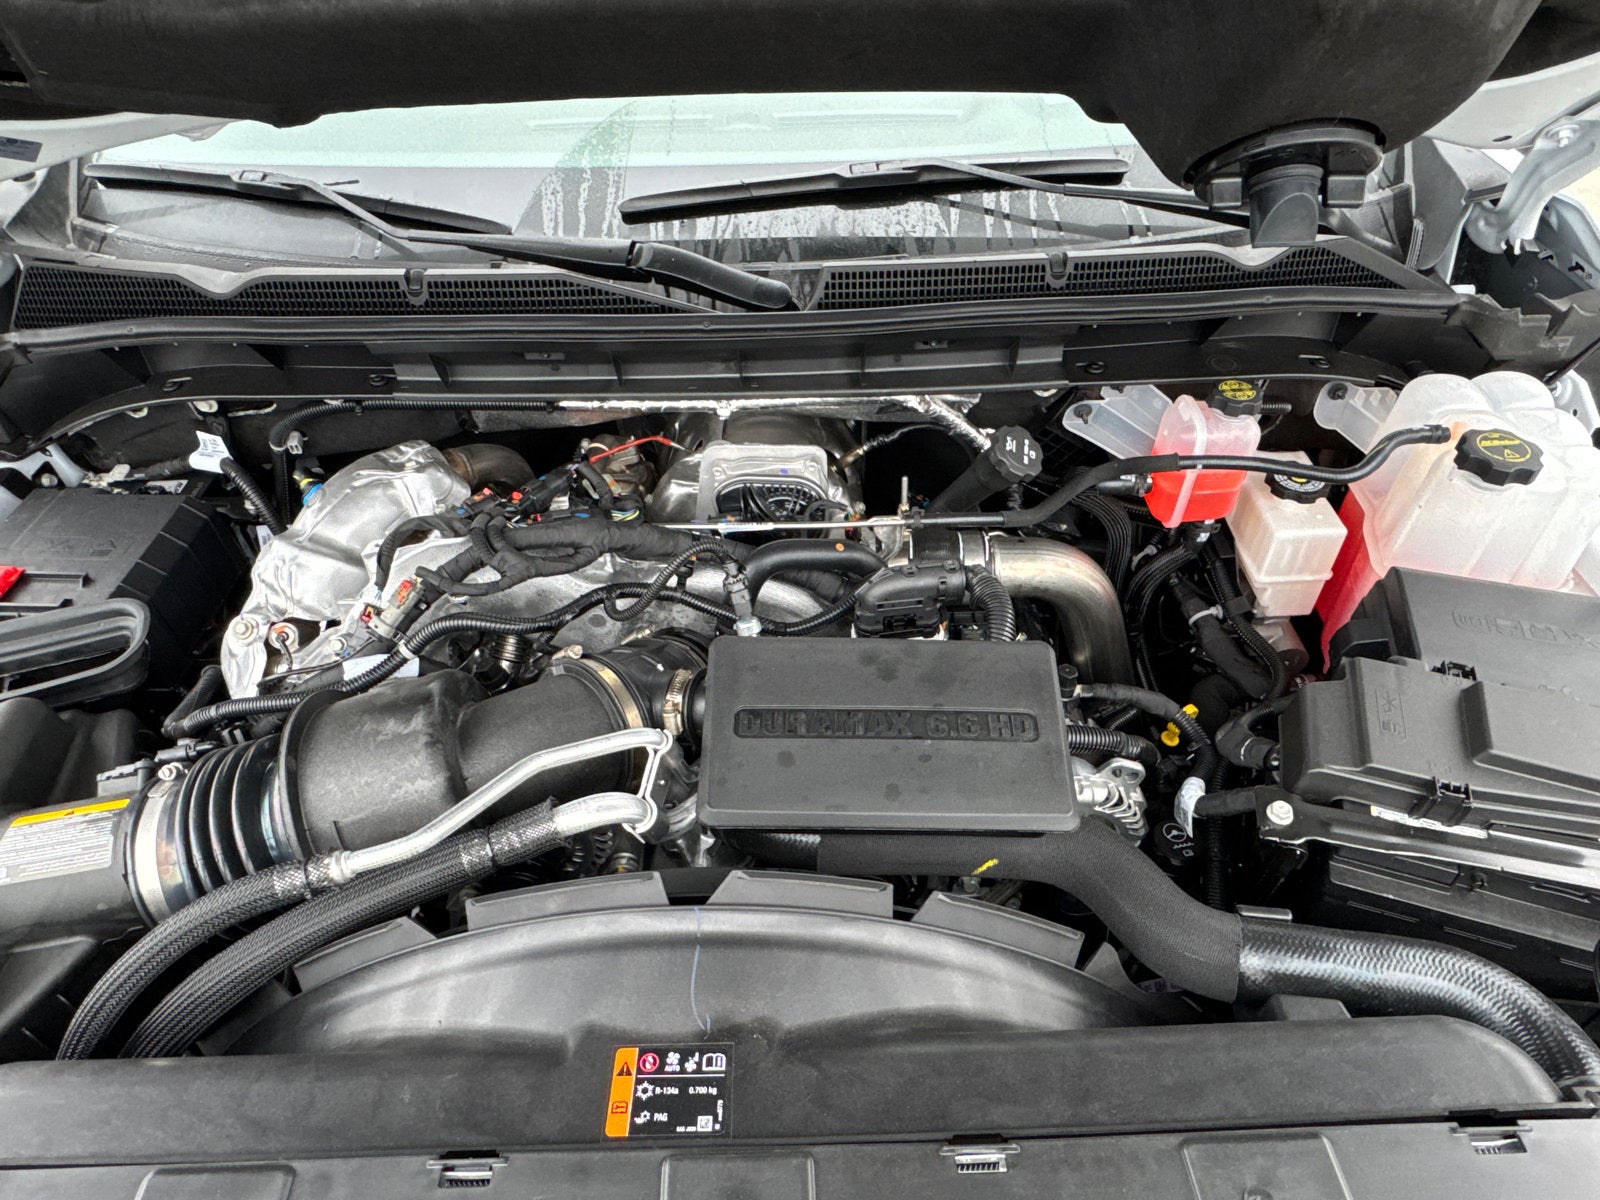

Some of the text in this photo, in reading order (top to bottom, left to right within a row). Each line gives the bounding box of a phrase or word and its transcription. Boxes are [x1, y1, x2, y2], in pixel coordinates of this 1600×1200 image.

[739, 710, 1036, 738] DURAMAX 6.6 HD
[655, 1087, 679, 1095] R-134a
[708, 1086, 718, 1095] kg
[653, 1112, 669, 1122] PAG
